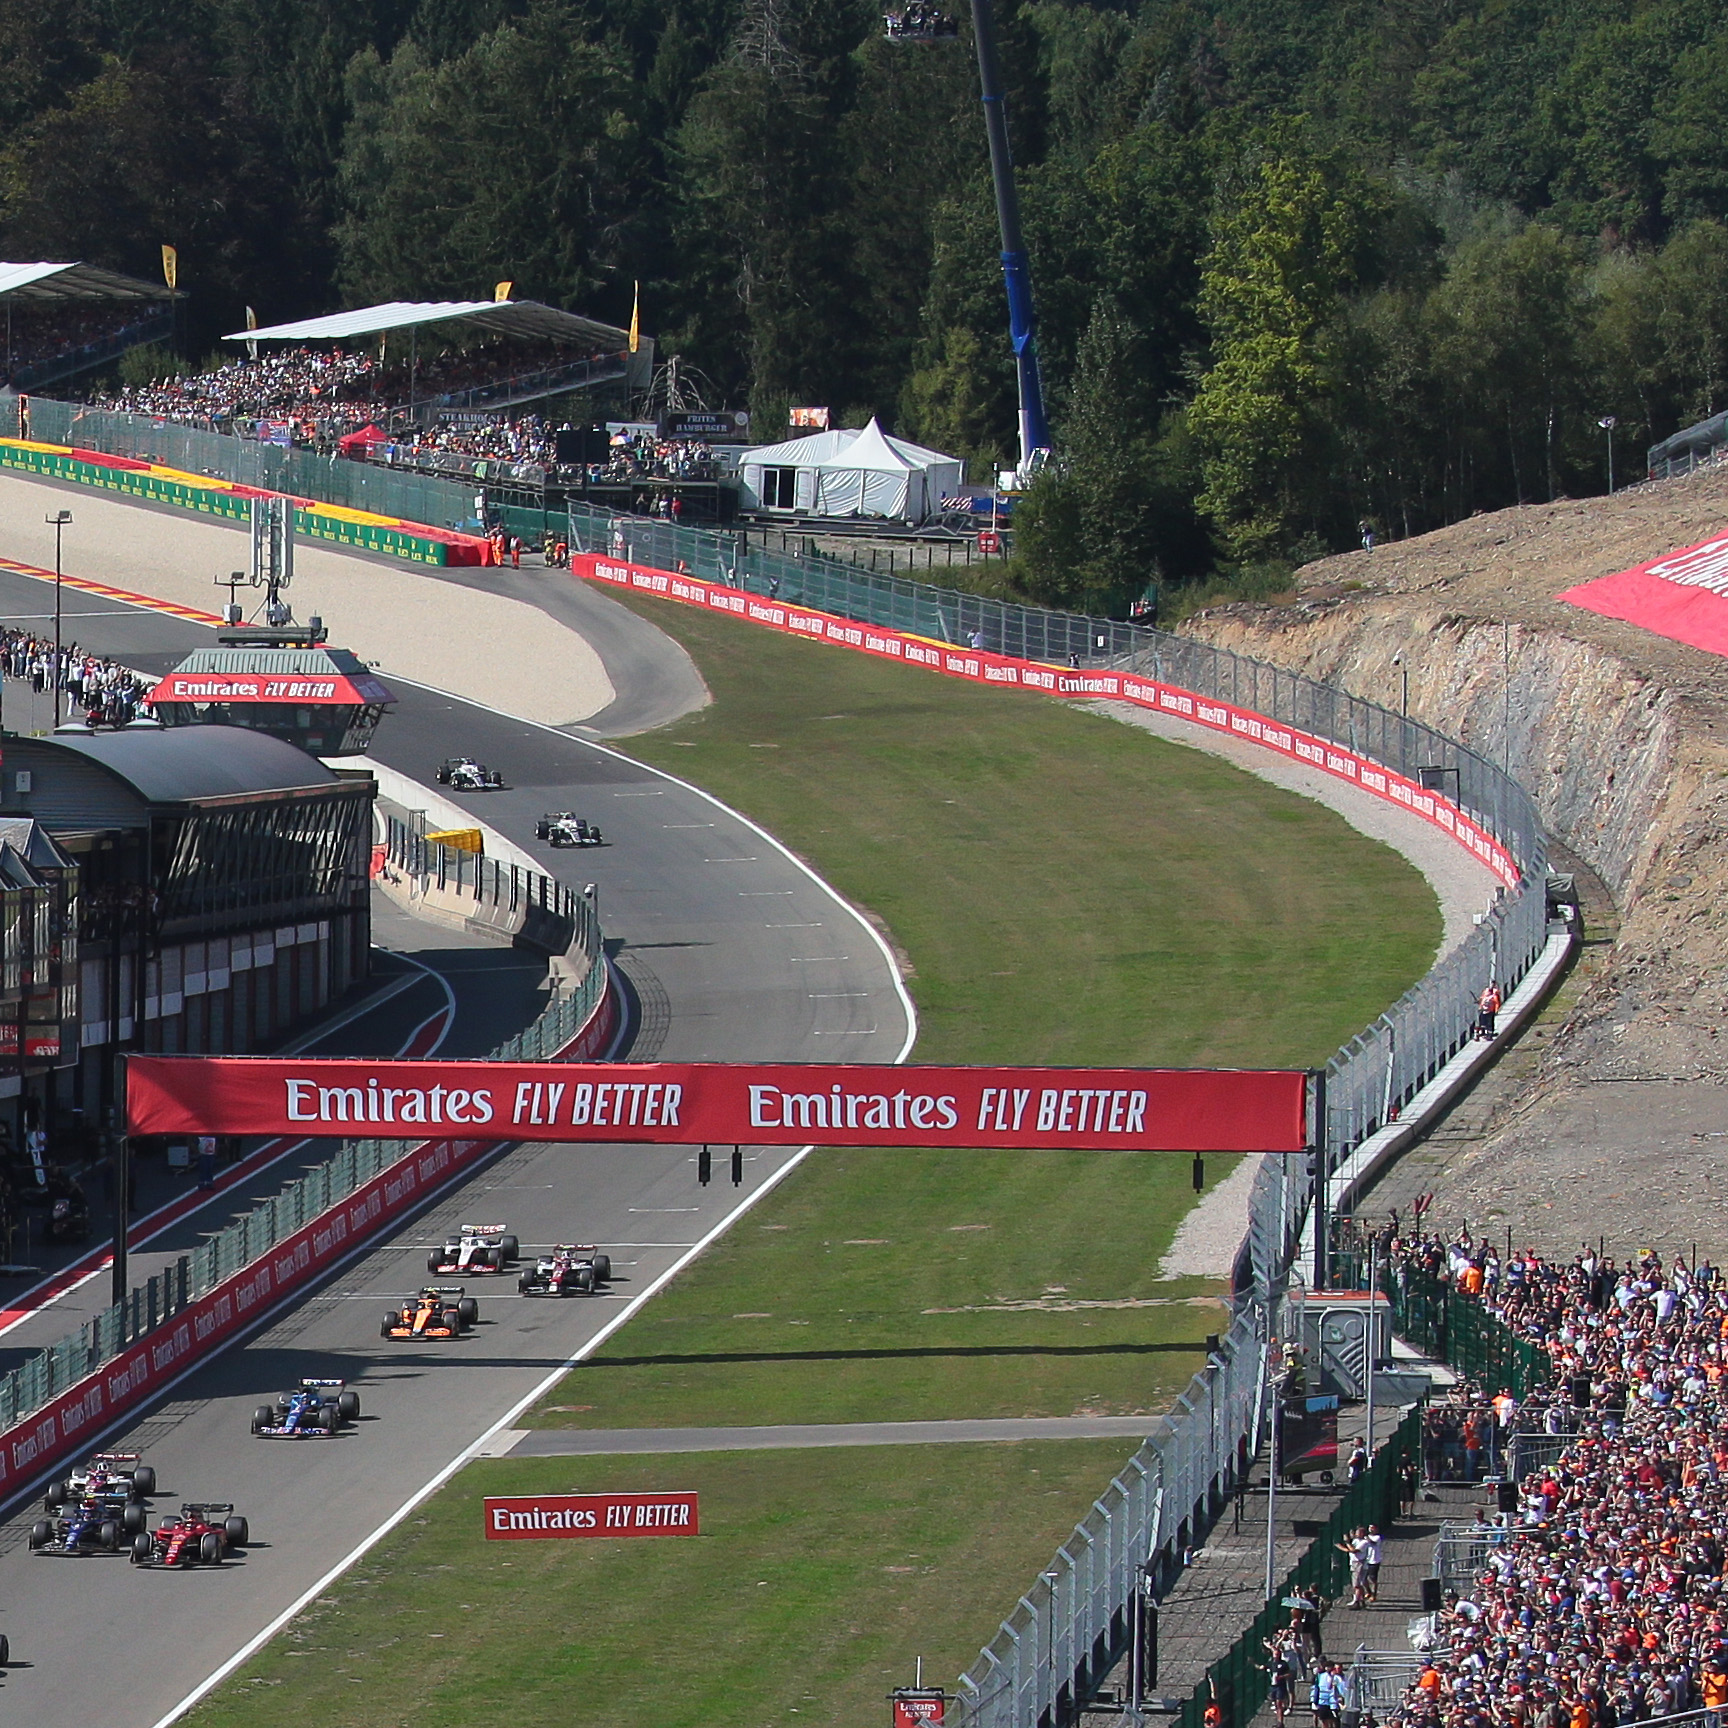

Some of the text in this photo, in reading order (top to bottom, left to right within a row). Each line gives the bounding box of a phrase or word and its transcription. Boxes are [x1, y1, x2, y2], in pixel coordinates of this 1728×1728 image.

[676, 424, 728, 433] HAMBURGER
[686, 415, 717, 423] FRITES
[174, 681, 335, 698] Emirates FLY BETTER
[286, 1078, 682, 1126] Emirates FLY BETTER
[748, 1084, 1147, 1132] Emirates FLY BETTER
[493, 1505, 689, 1529] Emirates FLY BETTER
